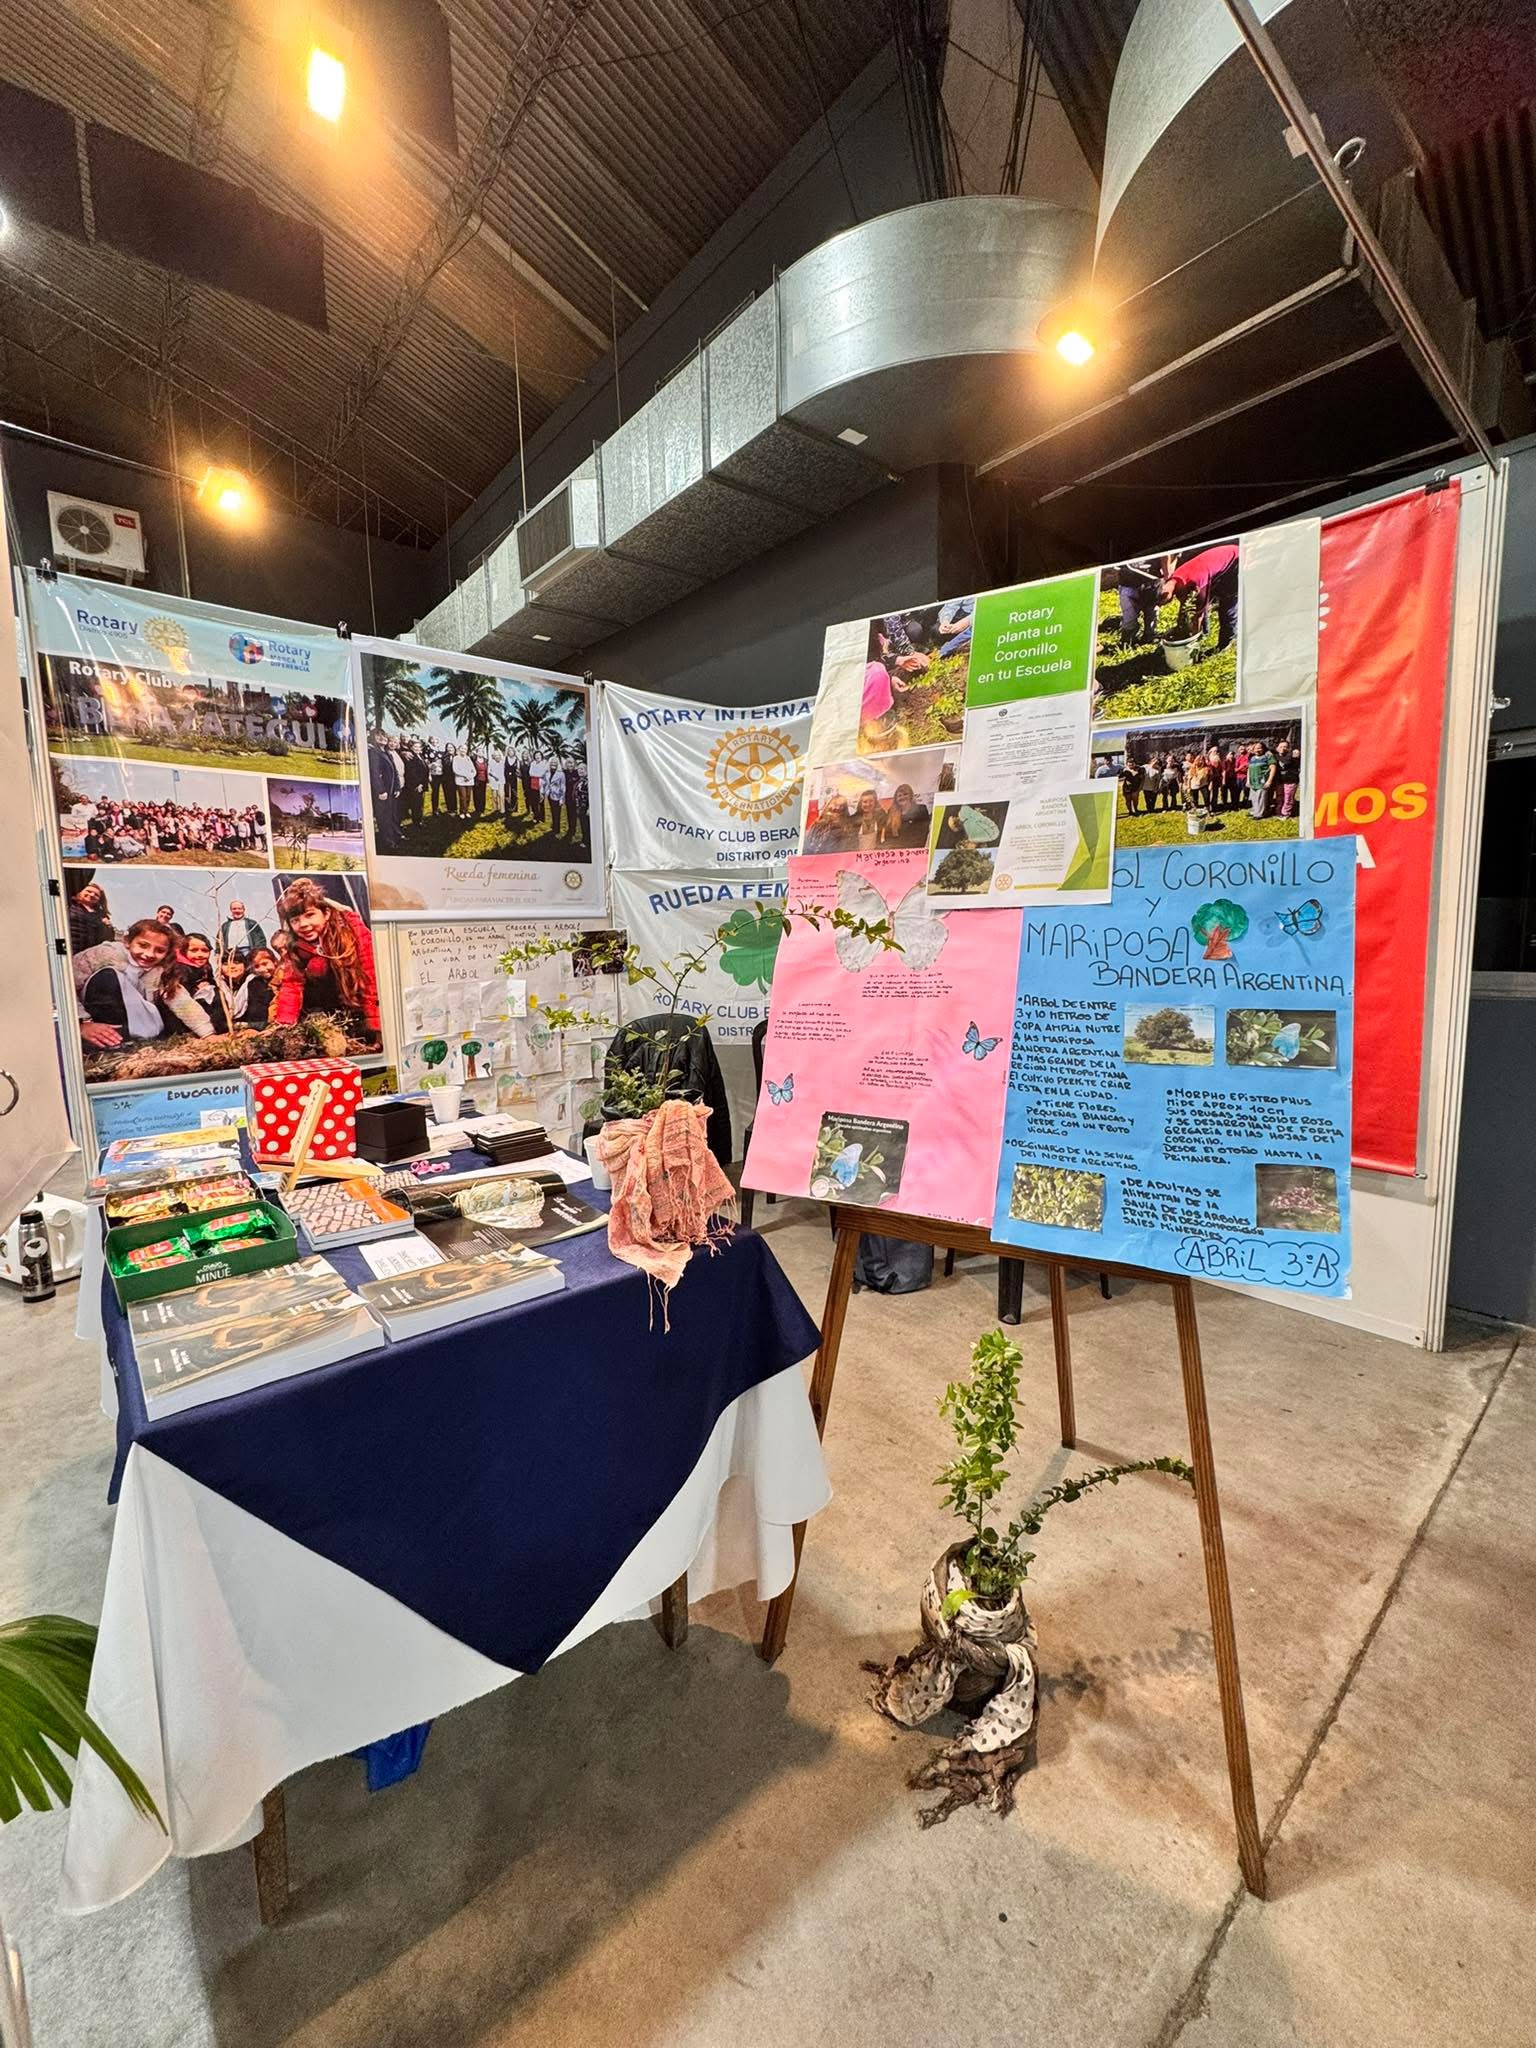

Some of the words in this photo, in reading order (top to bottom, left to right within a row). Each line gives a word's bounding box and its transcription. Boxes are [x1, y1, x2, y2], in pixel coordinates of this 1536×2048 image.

[76, 609, 138, 635] Rotary
[1009, 606, 1055, 624] Rotary
[997, 627, 1041, 647] planta
[1045, 623, 1062, 635] un
[269, 640, 311, 660] Rotary
[994, 642, 1058, 663] Coronillo
[69, 659, 130, 684] Rotary
[135, 670, 172, 689] Club
[977, 672, 994, 684] en
[998, 669, 1011, 681] tu
[1015, 658, 1072, 677] Escuela
[619, 708, 706, 736] ROTARY
[732, 734, 775, 747] ROTARY
[720, 785, 791, 811] INTERNATIONAL
[656, 817, 714, 841] ROTARY
[718, 830, 757, 843] CLUB
[760, 825, 801, 842] BERA
[716, 850, 771, 862] DISTRITO
[444, 862, 487, 881] Rueda
[483, 863, 540, 887] femenina
[648, 884, 734, 915] RUEDA
[419, 970, 436, 985] EL
[1088, 960, 1217, 990] BANDERA
[716, 1005, 759, 1019] CLUB
[1062, 999, 1078, 1009] DE
[1079, 1000, 1117, 1011] ENTRE
[1016, 1008, 1024, 1018] 3
[1035, 1009, 1046, 1019] 10
[1049, 1011, 1092, 1021] METROS
[1094, 1012, 1110, 1021] DE
[1014, 1020, 1042, 1032] COPA
[1085, 1024, 1121, 1034] NUTRE
[1012, 1042, 1059, 1055] BANDERA
[1011, 1053, 1022, 1061] LA
[1047, 1055, 1086, 1067] GRANDE
[1089, 1060, 1103, 1069] DE
[1017, 1083, 1043, 1095] ESTA
[1044, 1086, 1058, 1096] EN
[1174, 1087, 1226, 1100] MORPHO
[1166, 1106, 1187, 1116] SUS
[1189, 1109, 1234, 1119] ORUGAS
[1235, 1112, 1258, 1122] SON
[1300, 1116, 1333, 1127] ROJO
[1249, 1105, 1265, 1114] 10
[1027, 1118, 1055, 1127] VERDE
[1060, 1120, 1080, 1129] CON
[1082, 1122, 1096, 1130] UN
[1098, 1123, 1130, 1134] FRUTO
[1276, 1125, 1294, 1133] DE
[1299, 1126, 1345, 1138] FORMA
[1226, 1129, 1242, 1137] EN
[1269, 1132, 1308, 1142] HOJAS
[1041, 1152, 1078, 1164] NORTE
[1066, 1146, 1081, 1155] DE
[1162, 1143, 1198, 1153] DESDE
[1264, 1149, 1303, 1159] HASTA
[1126, 1177, 1143, 1188] DE
[1205, 1188, 1222, 1198] SE
[1161, 1204, 1178, 1214] DE
[1185, 1197, 1201, 1207] DE
[1121, 1206, 1159, 1220] FRUTA
